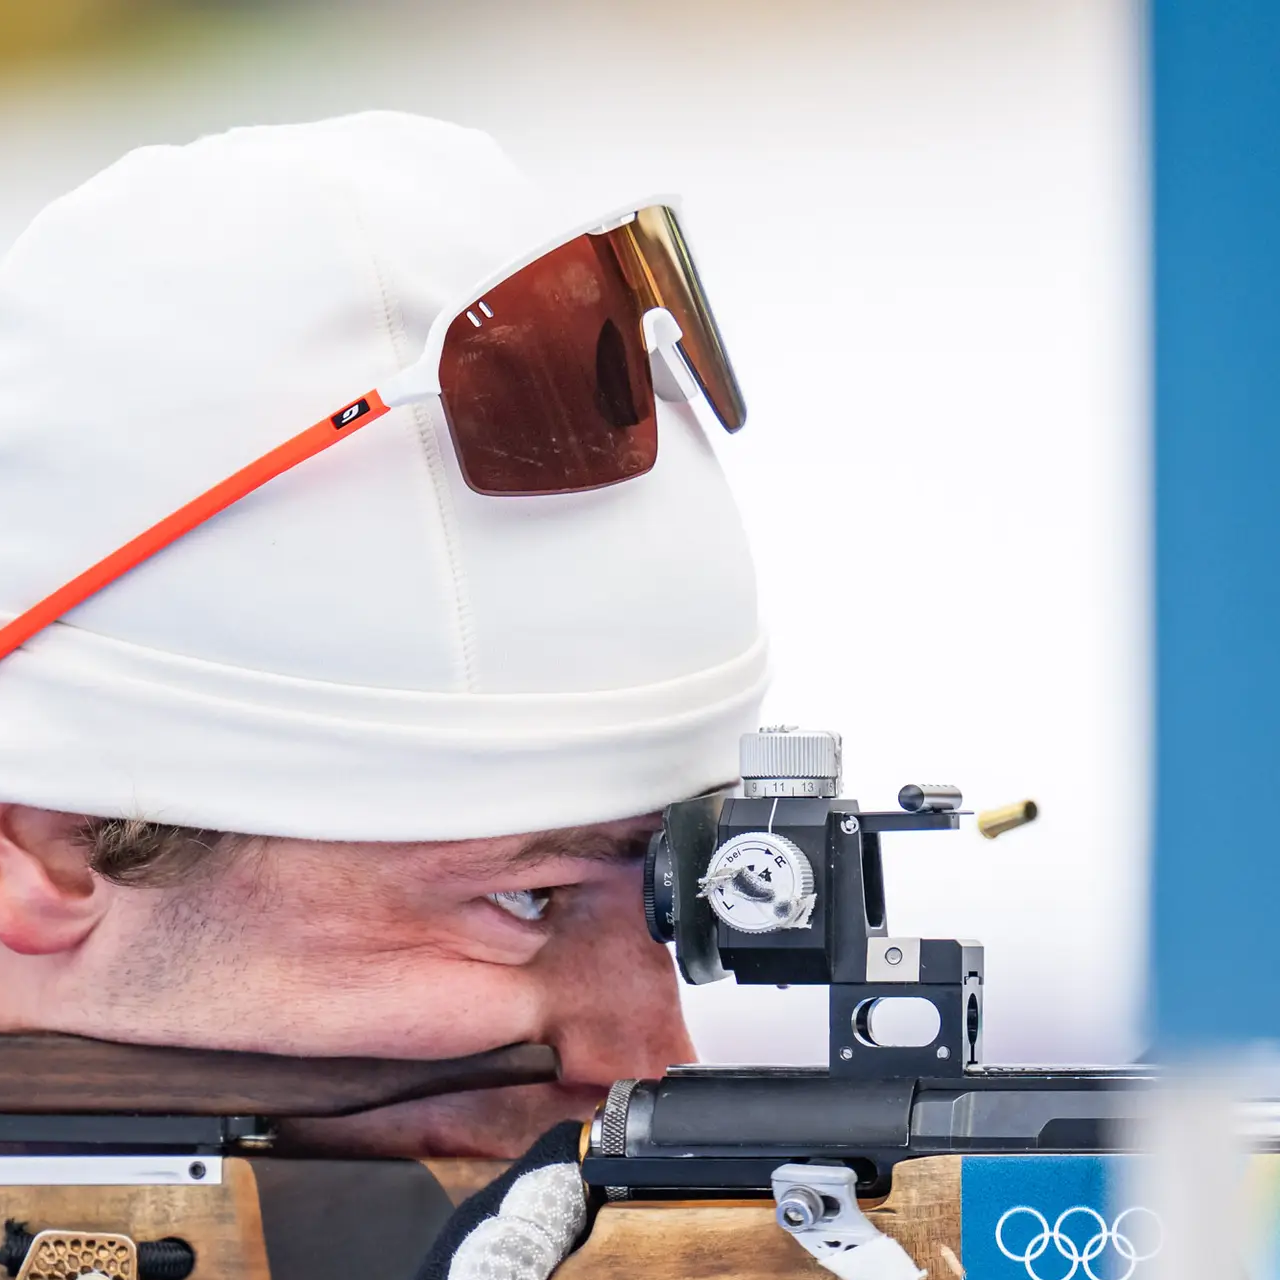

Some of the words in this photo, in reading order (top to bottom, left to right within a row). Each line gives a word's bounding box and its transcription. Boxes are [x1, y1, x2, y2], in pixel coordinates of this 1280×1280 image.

[751, 782, 757, 793] 9
[773, 782, 785, 793] 11
[801, 782, 814, 793] 13
[774, 855, 787, 868] R
[722, 901, 735, 911] L
